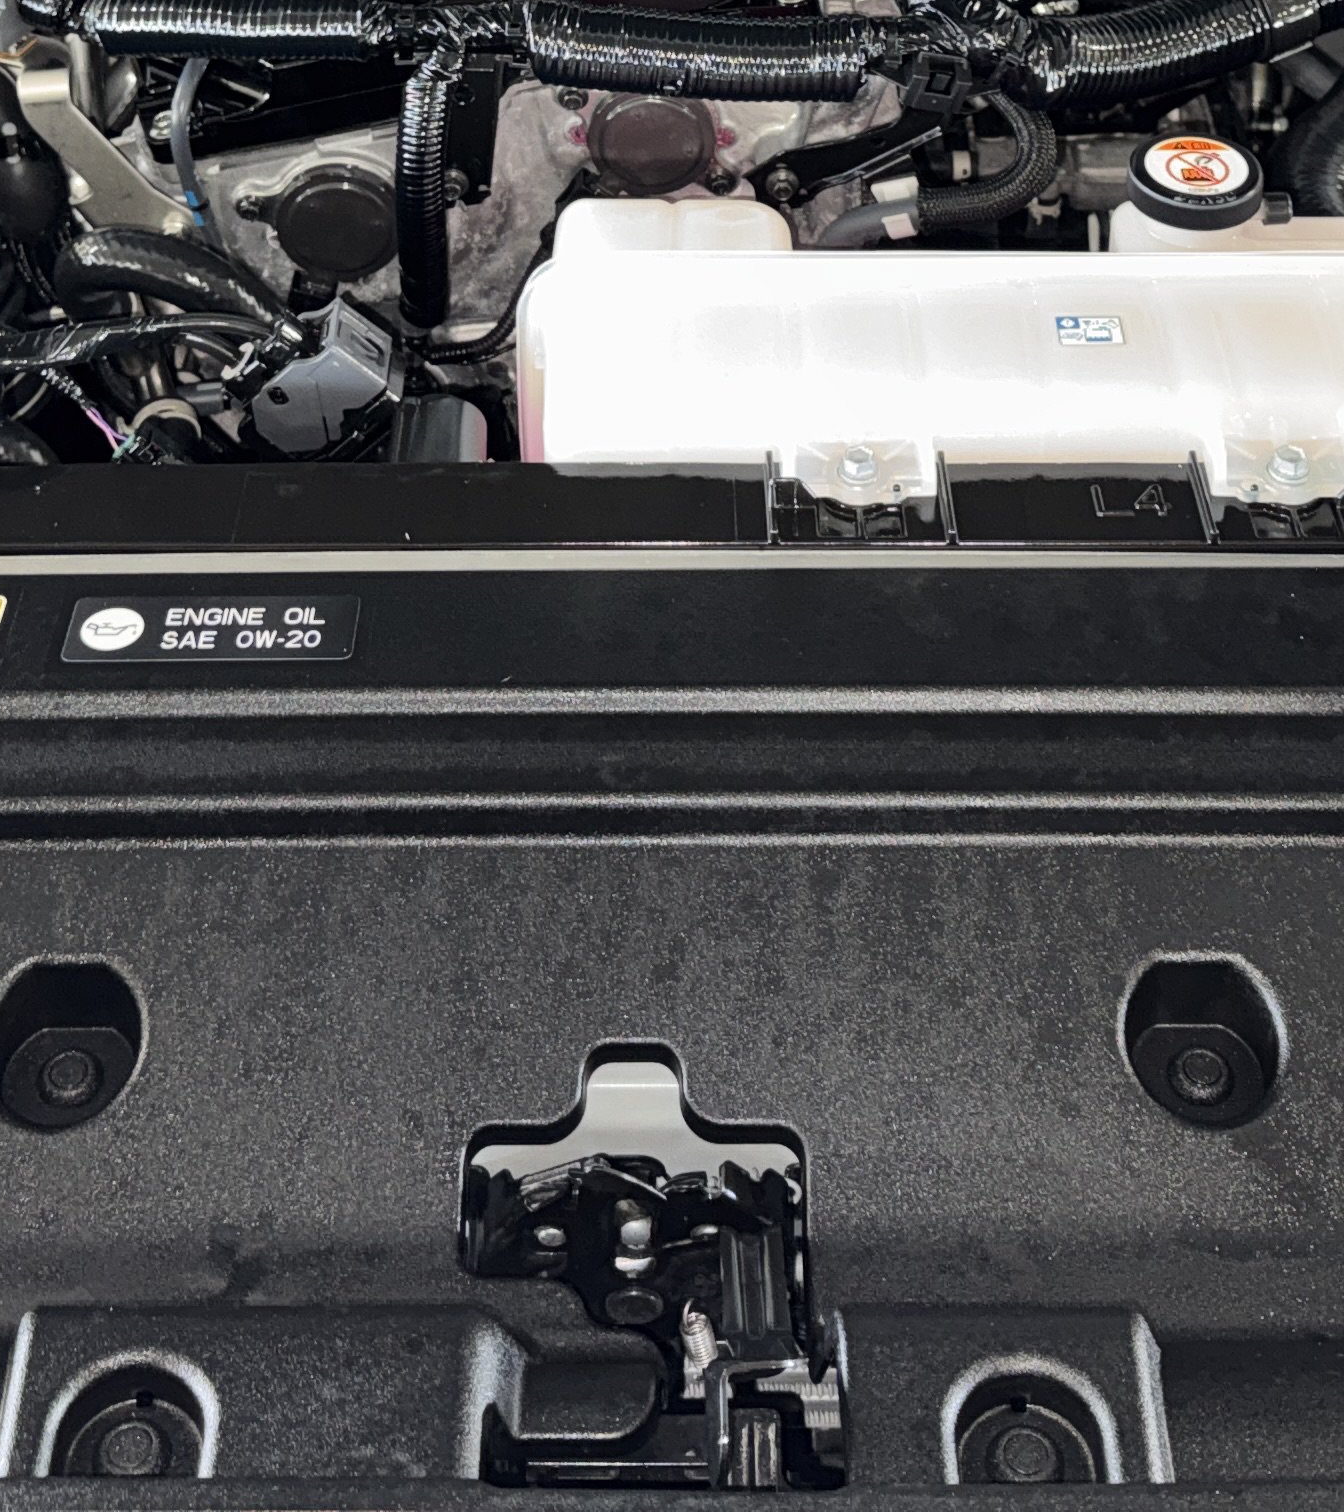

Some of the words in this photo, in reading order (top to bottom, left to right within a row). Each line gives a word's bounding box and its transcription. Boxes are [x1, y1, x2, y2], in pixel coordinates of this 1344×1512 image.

[164, 607, 267, 627] ENGINE
[284, 606, 326, 626] OIL
[159, 630, 218, 650] SAE
[235, 629, 323, 649] 0W-20
